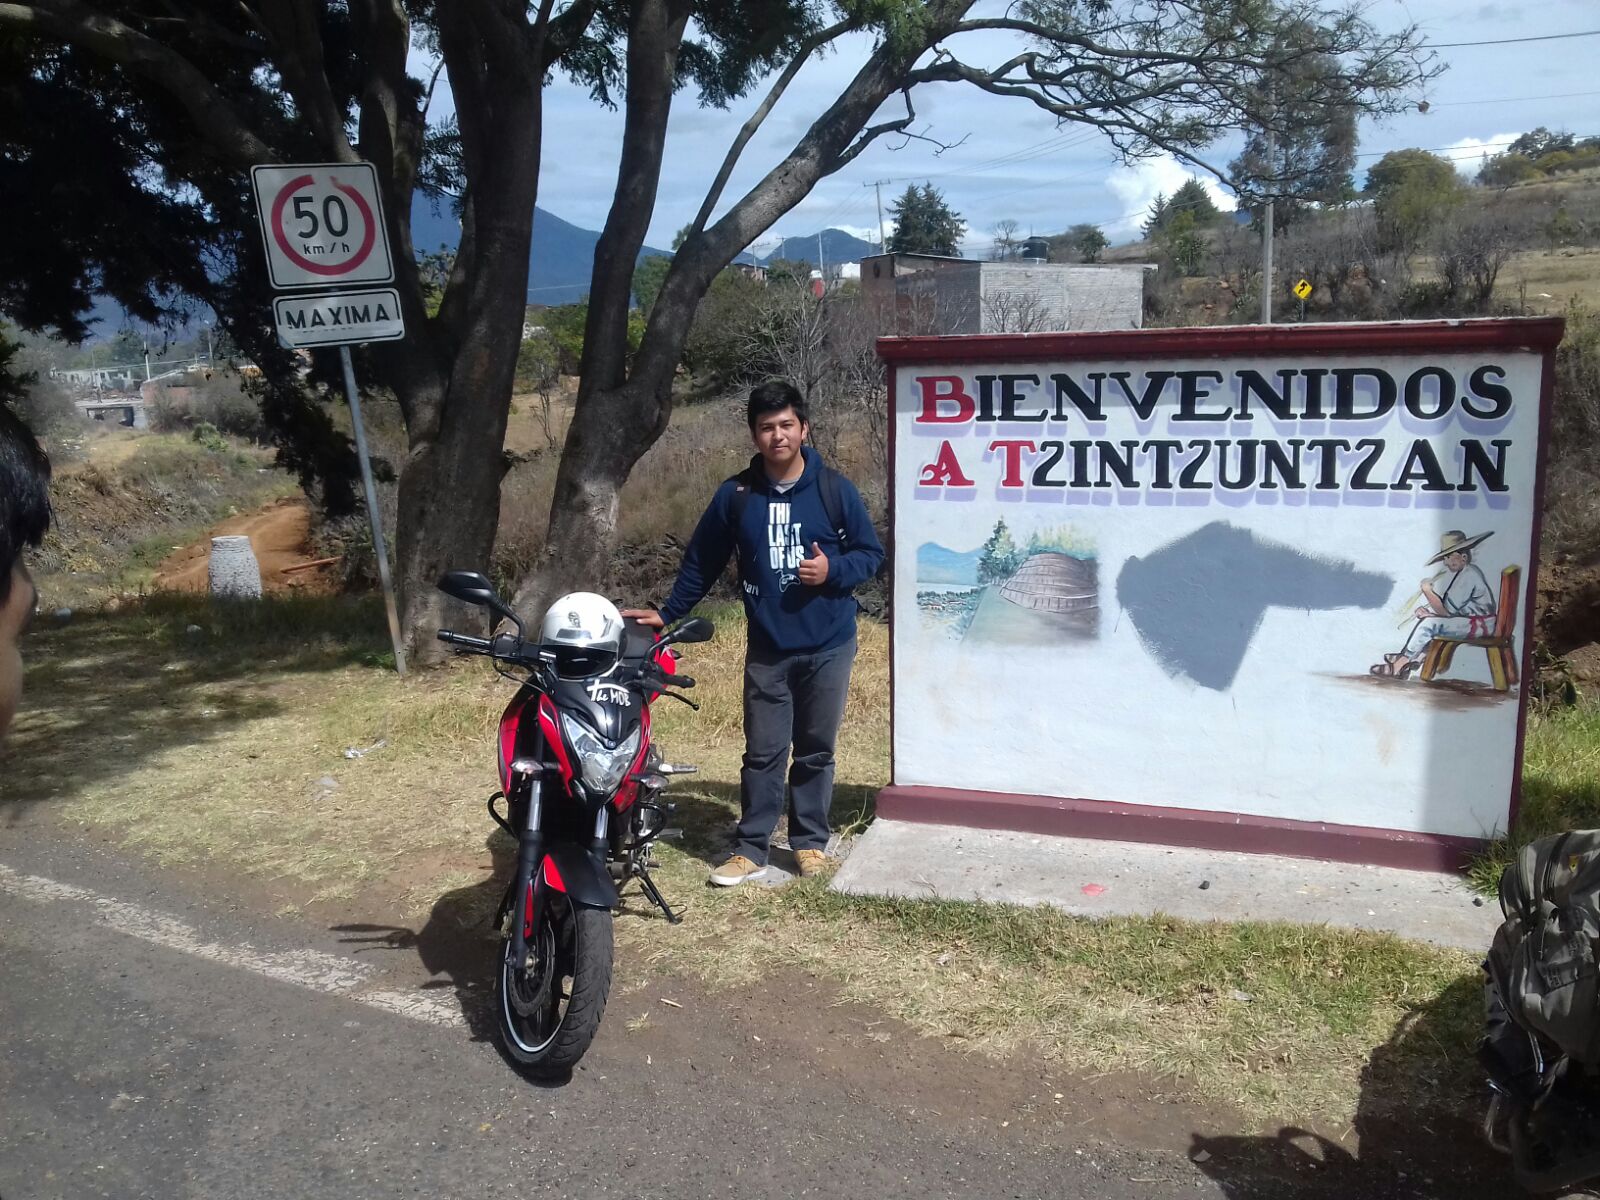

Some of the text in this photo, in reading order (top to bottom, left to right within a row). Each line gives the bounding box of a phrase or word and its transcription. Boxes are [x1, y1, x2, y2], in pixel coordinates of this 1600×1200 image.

[293, 195, 349, 239] 50
[285, 304, 391, 329] MAXIMA
[915, 365, 1512, 423] BIENVENIDOS
[919, 438, 1512, 491] A TZINTZUNTZAN
[768, 523, 802, 547] LAST
[770, 545, 805, 569] OF US
